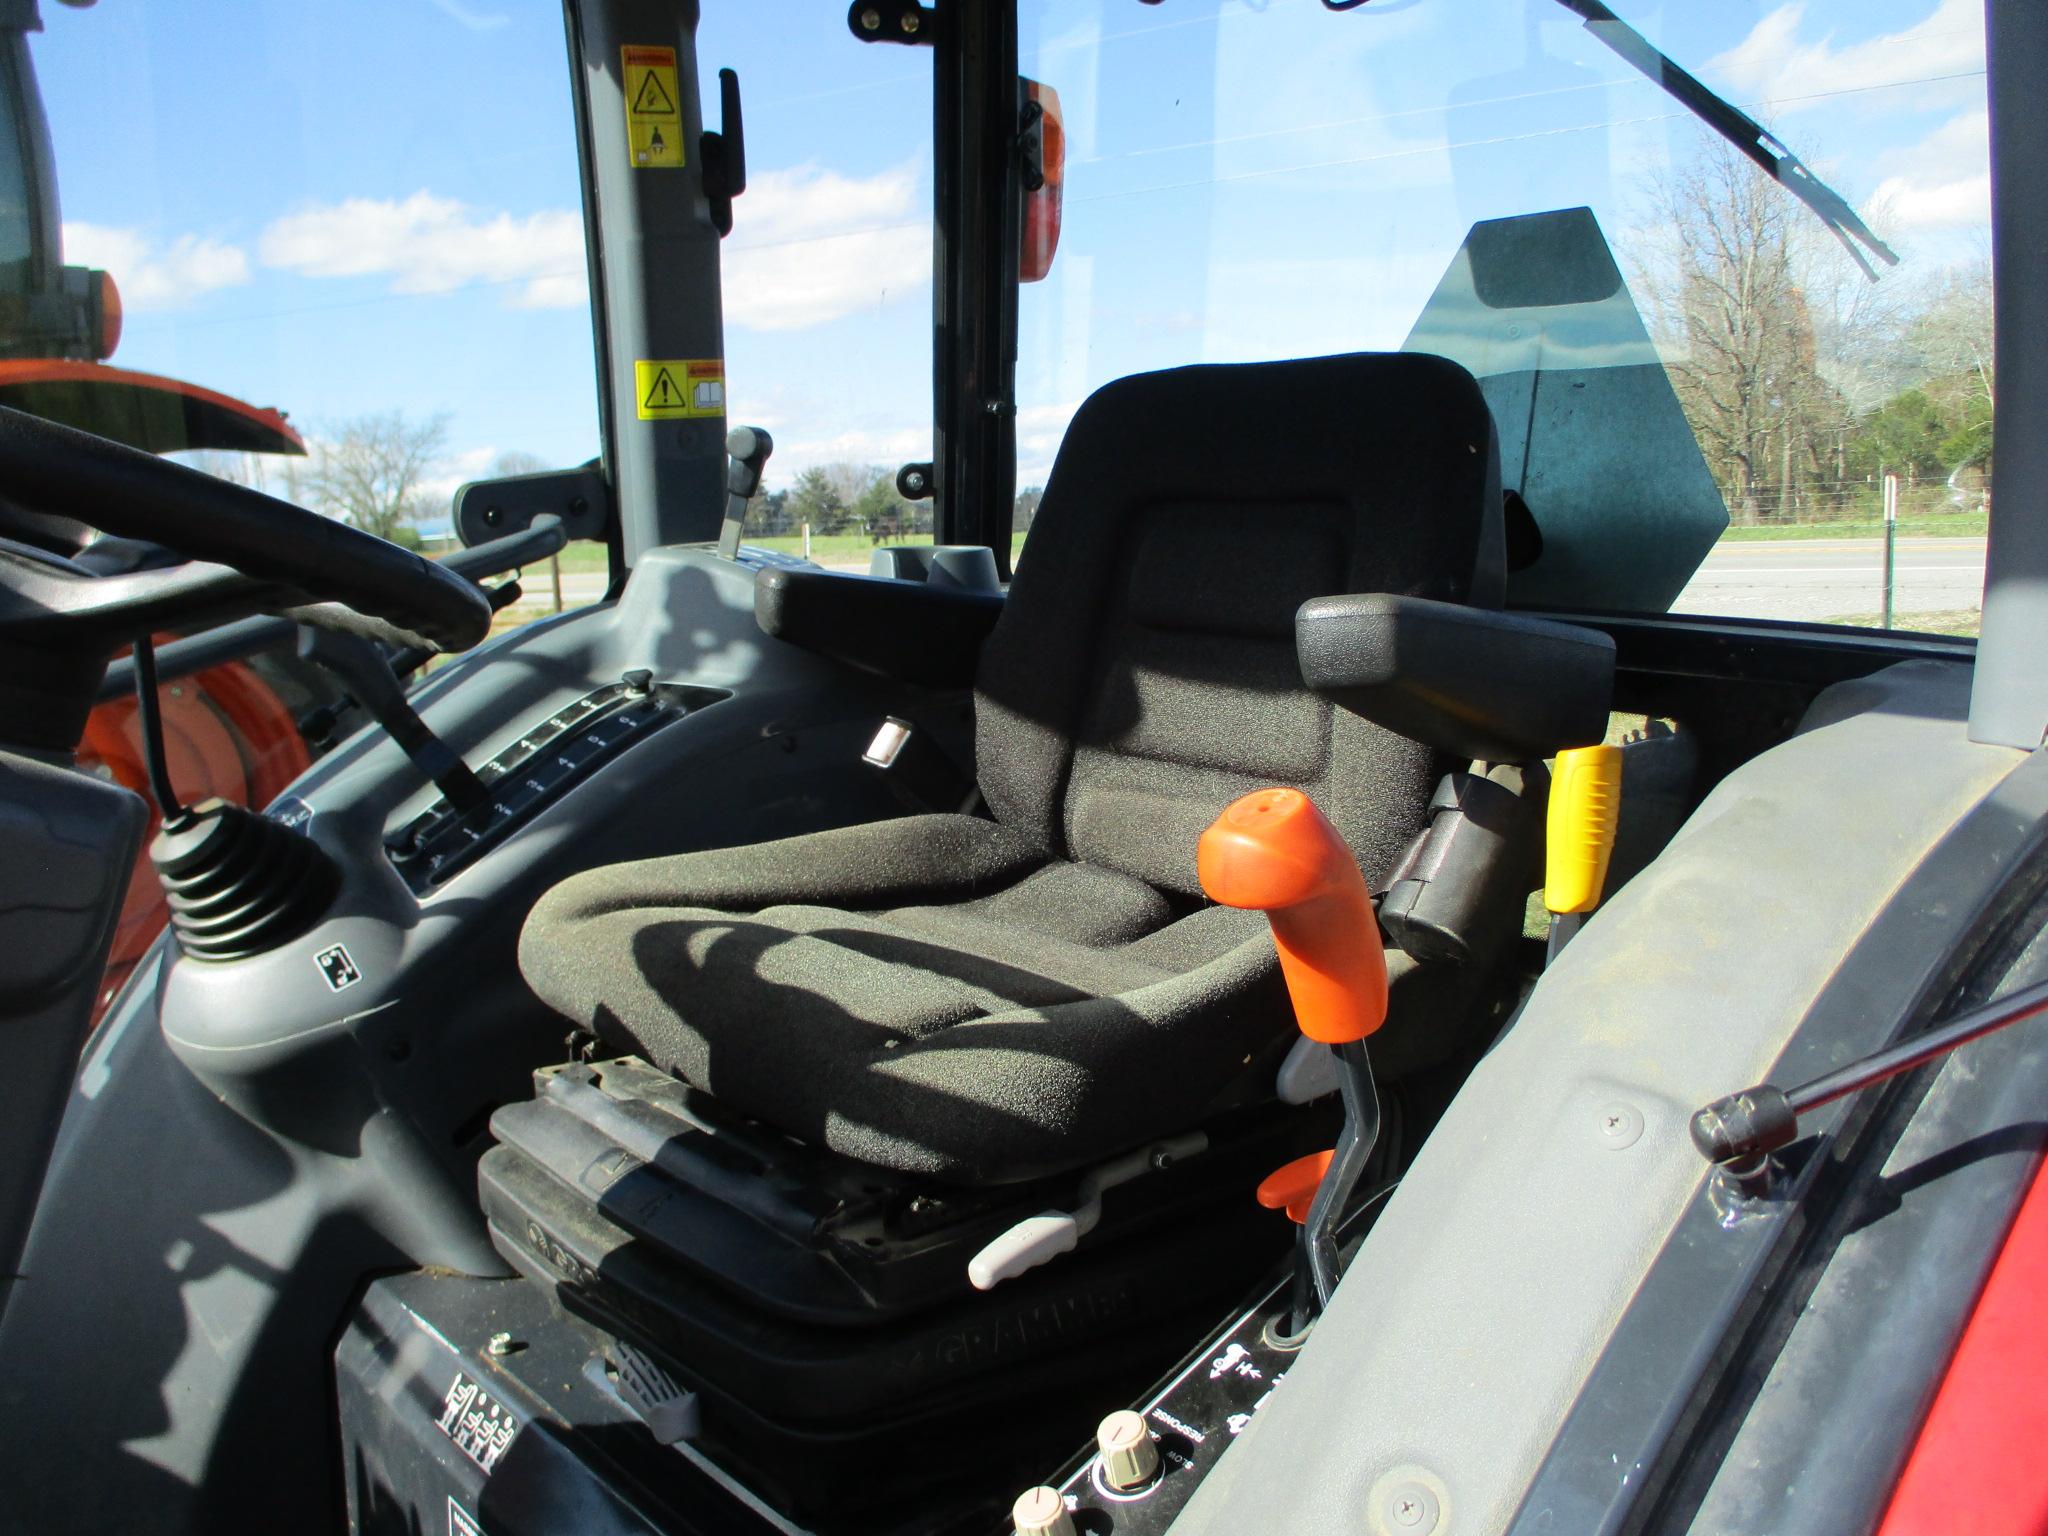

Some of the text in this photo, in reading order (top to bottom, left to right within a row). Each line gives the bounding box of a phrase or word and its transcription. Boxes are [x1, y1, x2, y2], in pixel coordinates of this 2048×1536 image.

[494, 802, 506, 812] 2
[1152, 1407, 1205, 1443] RESPONSE
[1166, 1450, 1194, 1470] SLOW
